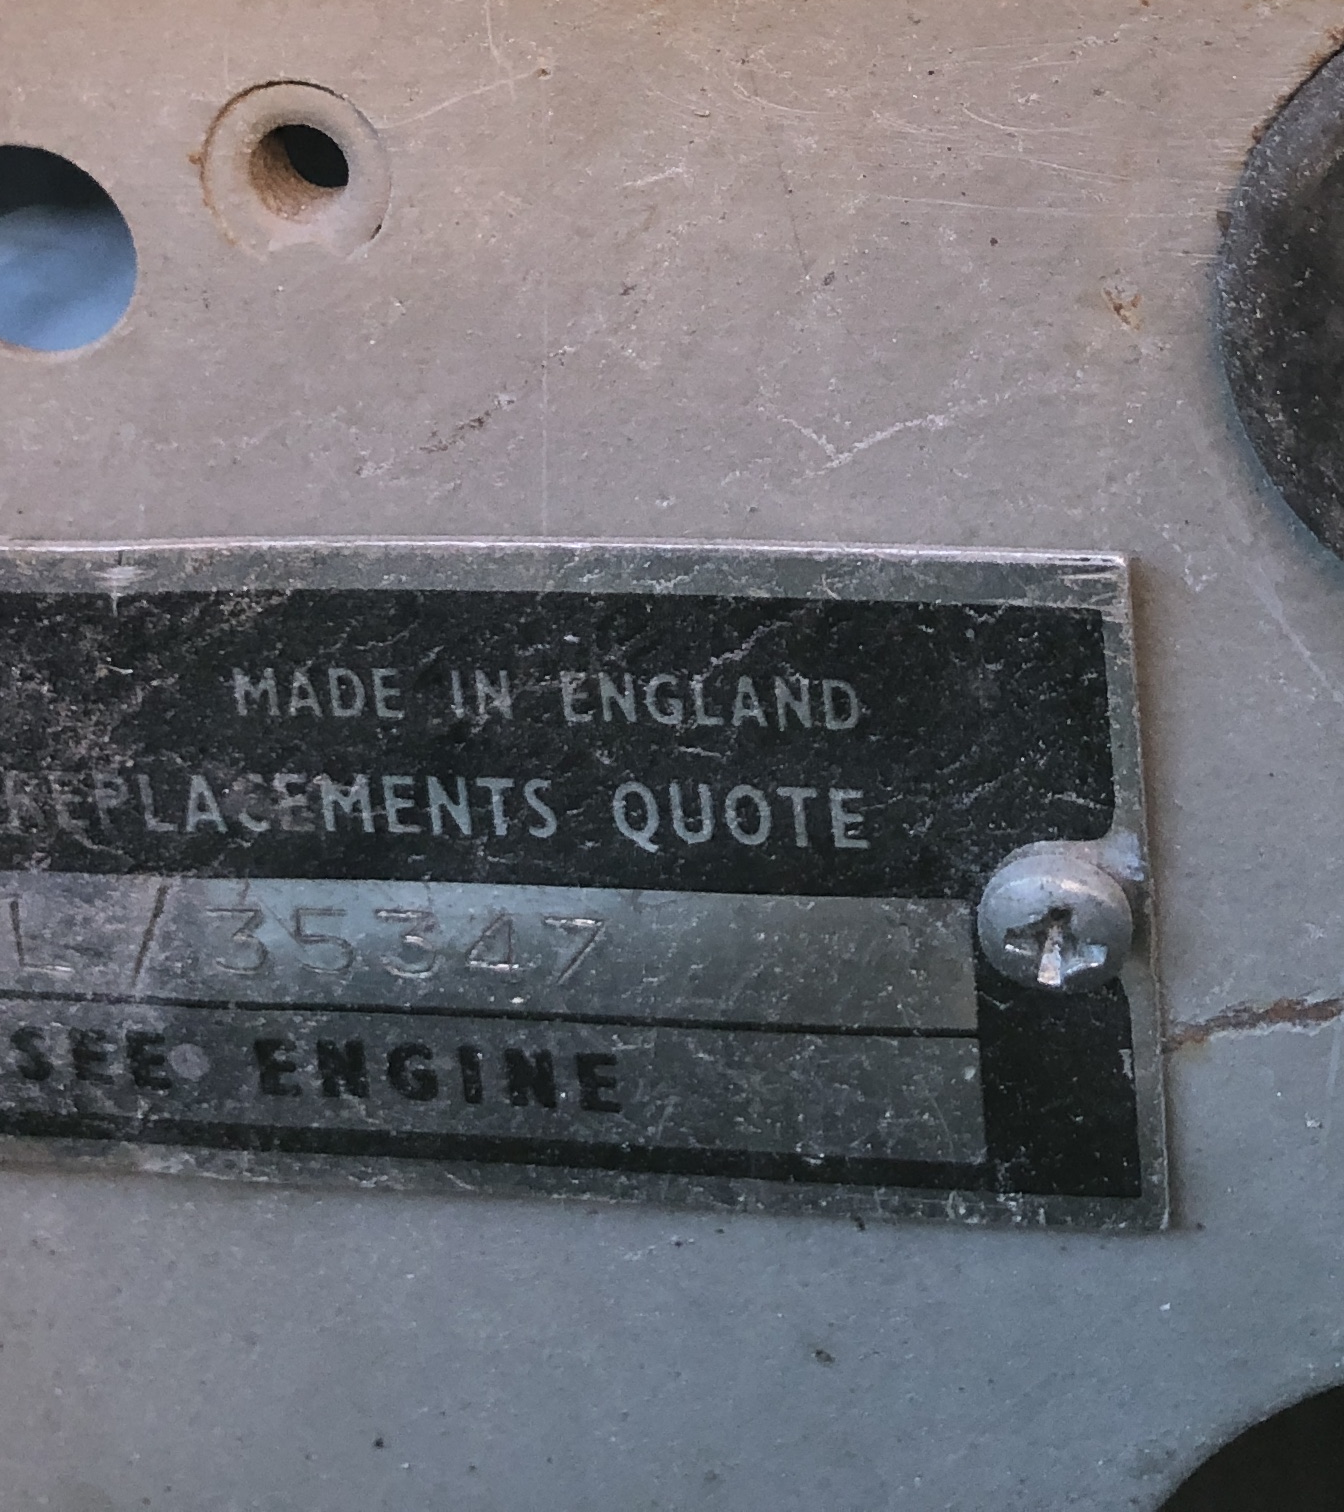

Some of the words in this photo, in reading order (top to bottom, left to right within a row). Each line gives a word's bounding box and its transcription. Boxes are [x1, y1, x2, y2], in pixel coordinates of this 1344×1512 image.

[231, 664, 407, 721] MADE
[450, 667, 517, 721] IN
[559, 667, 862, 732] ENGLAND
[6, 768, 558, 841] REPLACEMENTS
[609, 778, 872, 851] QUOTE
[9, 1023, 174, 1092] SEE
[256, 1034, 625, 1116] ENGINE
